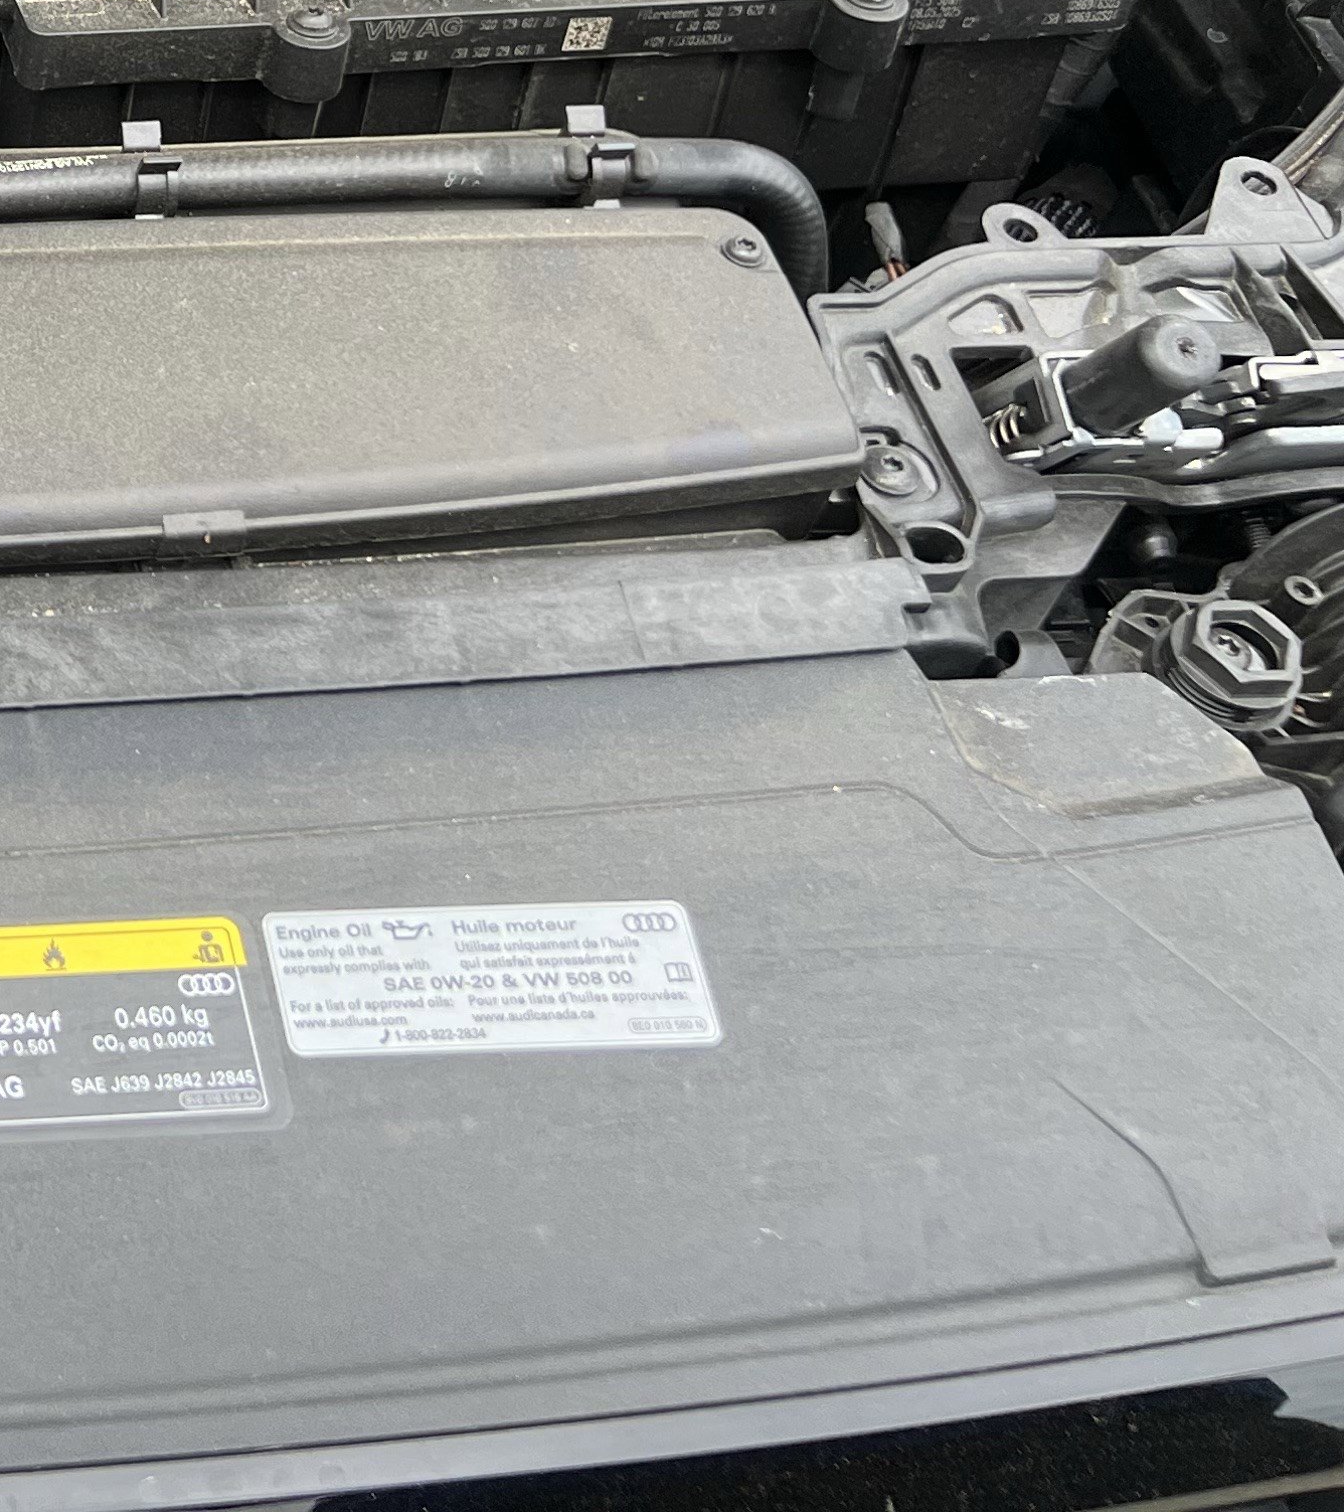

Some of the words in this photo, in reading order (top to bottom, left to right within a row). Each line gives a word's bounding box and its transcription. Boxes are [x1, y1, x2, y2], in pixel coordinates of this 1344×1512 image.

[365, 19, 415, 41] VW
[416, 17, 463, 38] AG
[276, 925, 340, 942] Engine
[346, 922, 372, 938] Oil
[451, 919, 500, 935] Huile
[505, 918, 577, 933] moteur
[278, 946, 305, 959] Use
[307, 945, 335, 959] only
[338, 943, 354, 957] oil
[357, 944, 384, 957] that
[455, 940, 501, 953] Utilisez
[504, 937, 579, 952] uniquement
[582, 936, 598, 949] de
[283, 961, 341, 977] expressly
[344, 959, 401, 975] complies
[402, 958, 431, 971] with
[460, 955, 480, 971] qui
[483, 954, 532, 969] satisfait
[535, 951, 626, 968] expressément
[383, 976, 425, 991] SAE
[430, 974, 495, 990] 0W-20
[502, 973, 519, 988] &
[522, 972, 559, 987] VW
[566, 971, 603, 985] 508
[608, 970, 633, 984] 00
[289, 1000, 311, 1012] For
[314, 1002, 323, 1012] a
[325, 998, 344, 1011] list
[347, 998, 361, 1010] of
[364, 996, 424, 1012] approved
[468, 994, 499, 1006] Pour
[501, 995, 525, 1005] une
[528, 993, 555, 1005] liste
[114, 1005, 176, 1029] 0.460
[181, 1004, 209, 1028] kg
[293, 1015, 408, 1029] www.audiusa.com
[472, 1009, 596, 1022] www.audicanada.ca
[13, 1038, 58, 1056] 0.501
[128, 1034, 153, 1053] eq
[70, 1076, 108, 1095] SAE
[110, 1076, 151, 1093] J639
[154, 1072, 203, 1090] J2842
[206, 1069, 257, 1088] J2845
